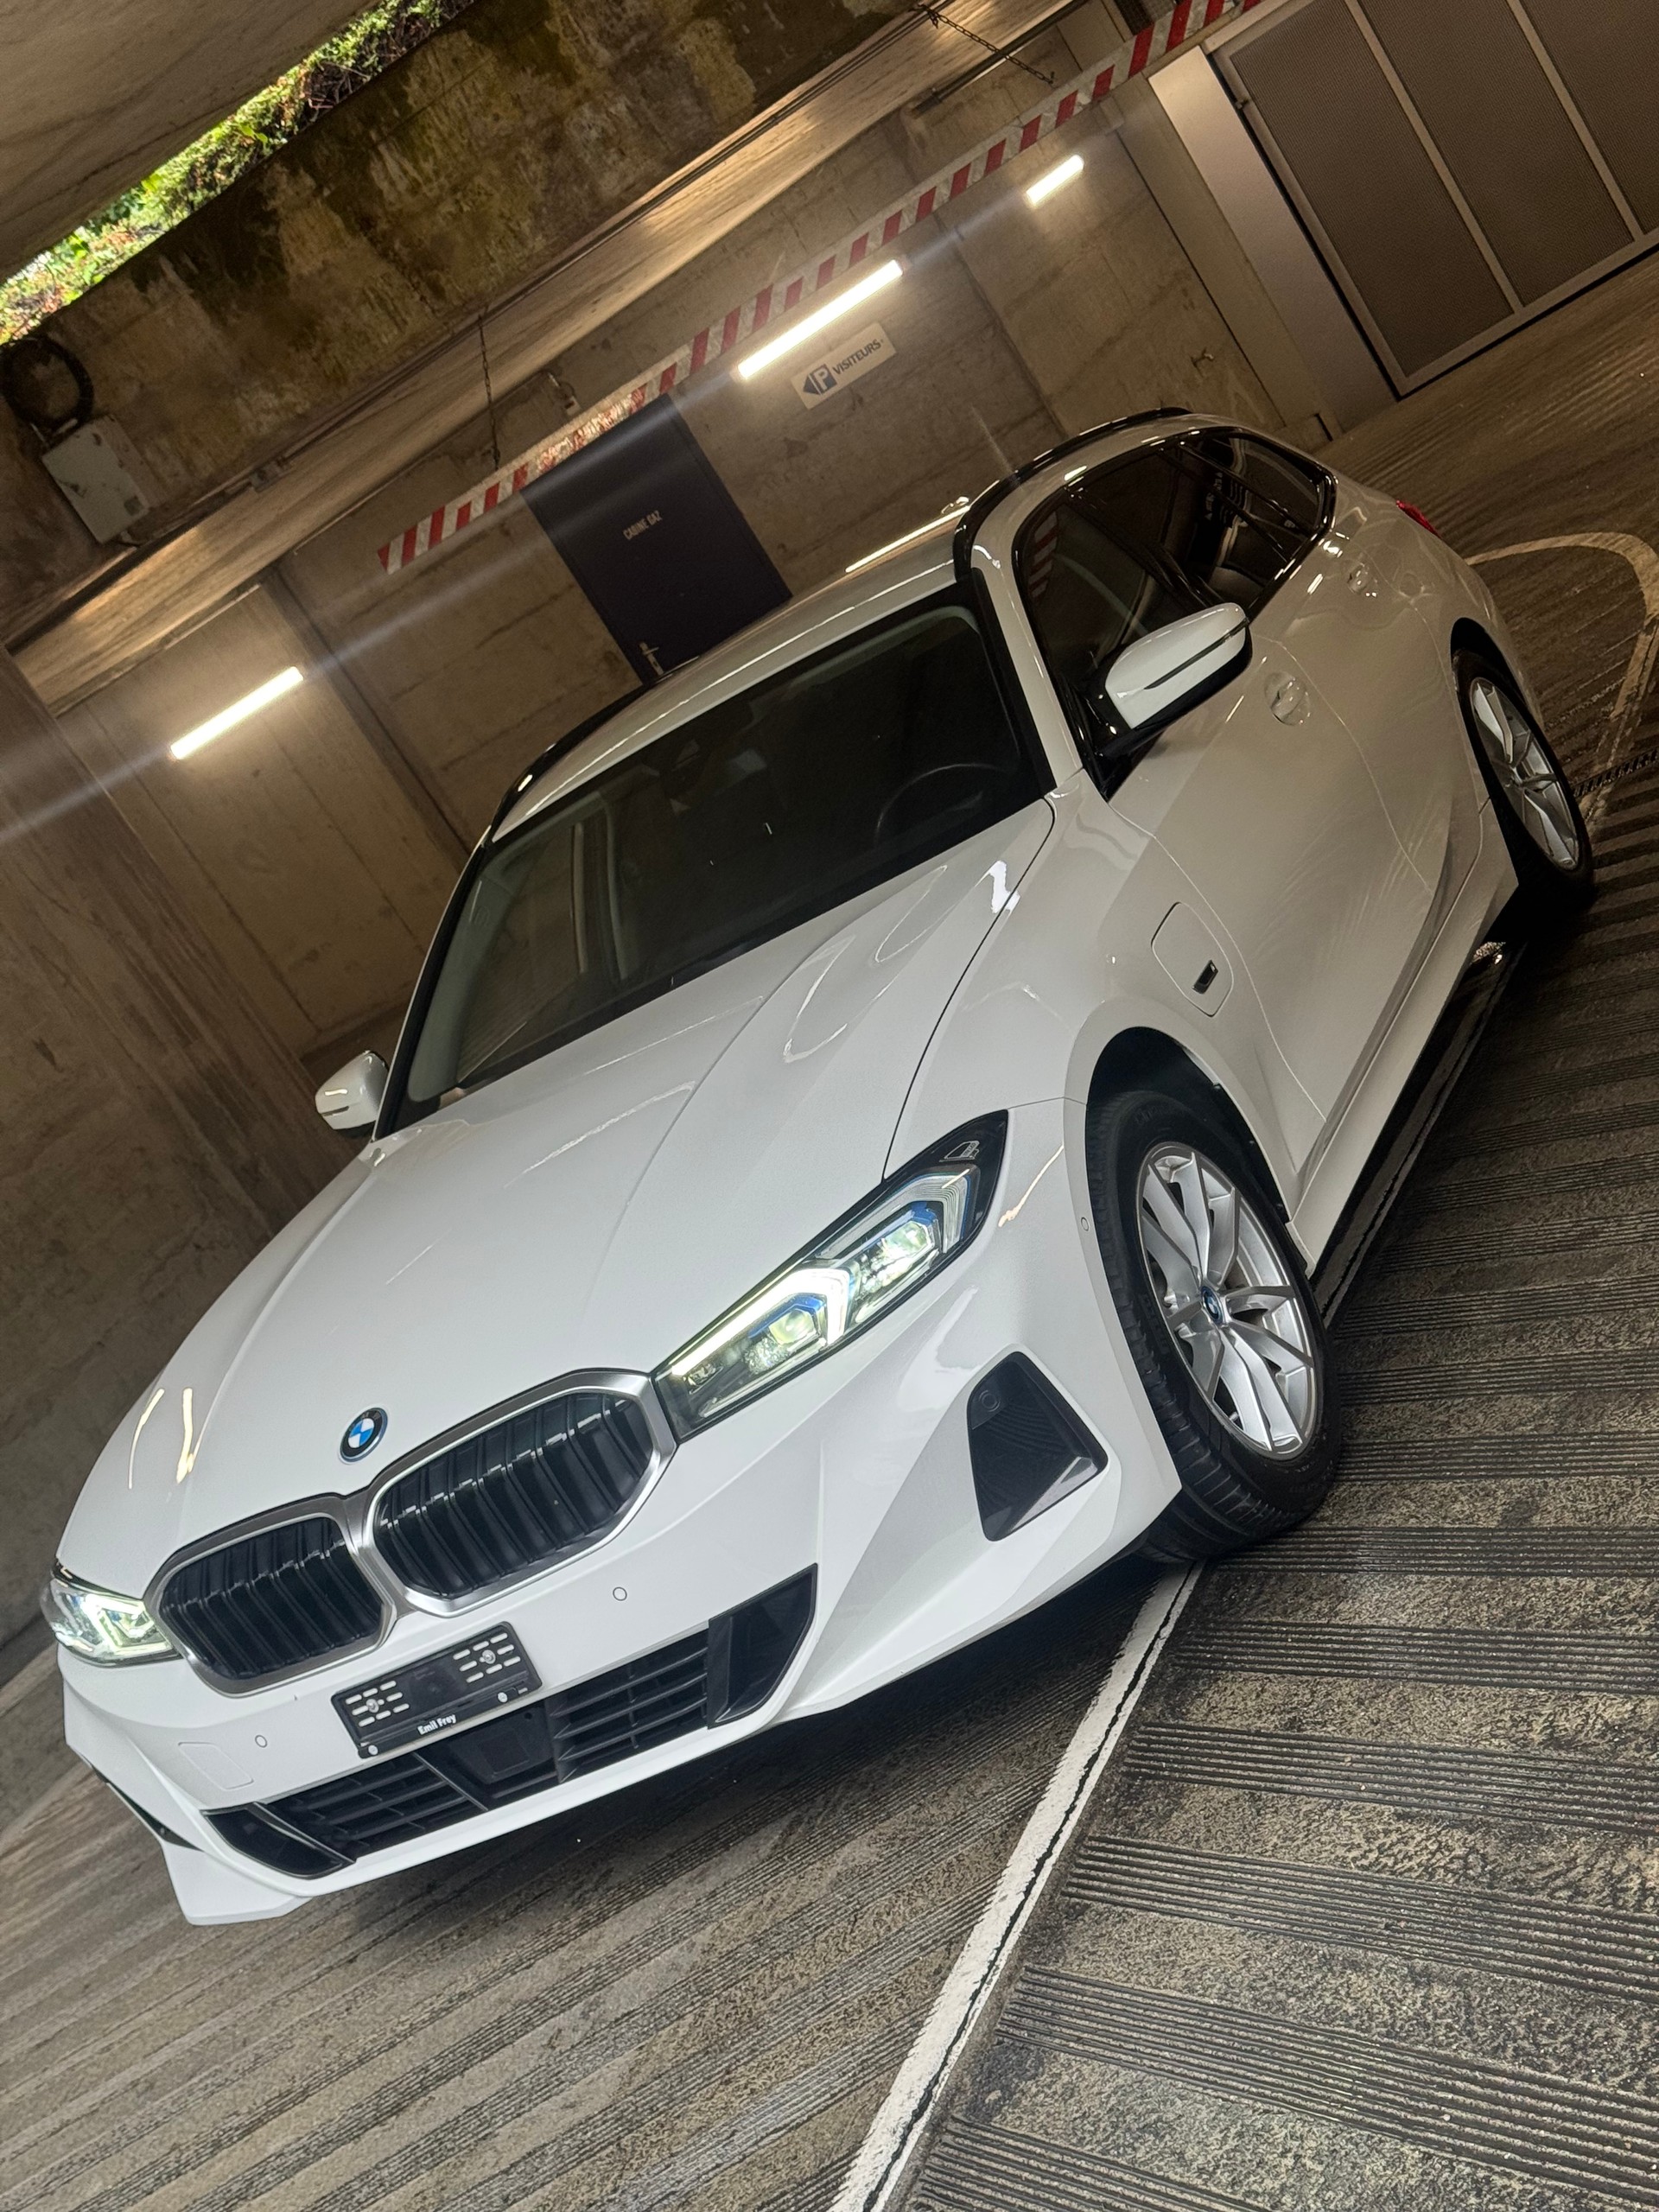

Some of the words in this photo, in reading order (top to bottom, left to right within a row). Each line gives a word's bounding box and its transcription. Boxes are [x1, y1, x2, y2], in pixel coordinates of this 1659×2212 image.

[813, 367, 829, 391] P
[832, 339, 881, 374] VISITEURS
[622, 518, 650, 540] CABINE
[416, 1719, 439, 1735] Emil
[436, 1713, 456, 1727] Frey
